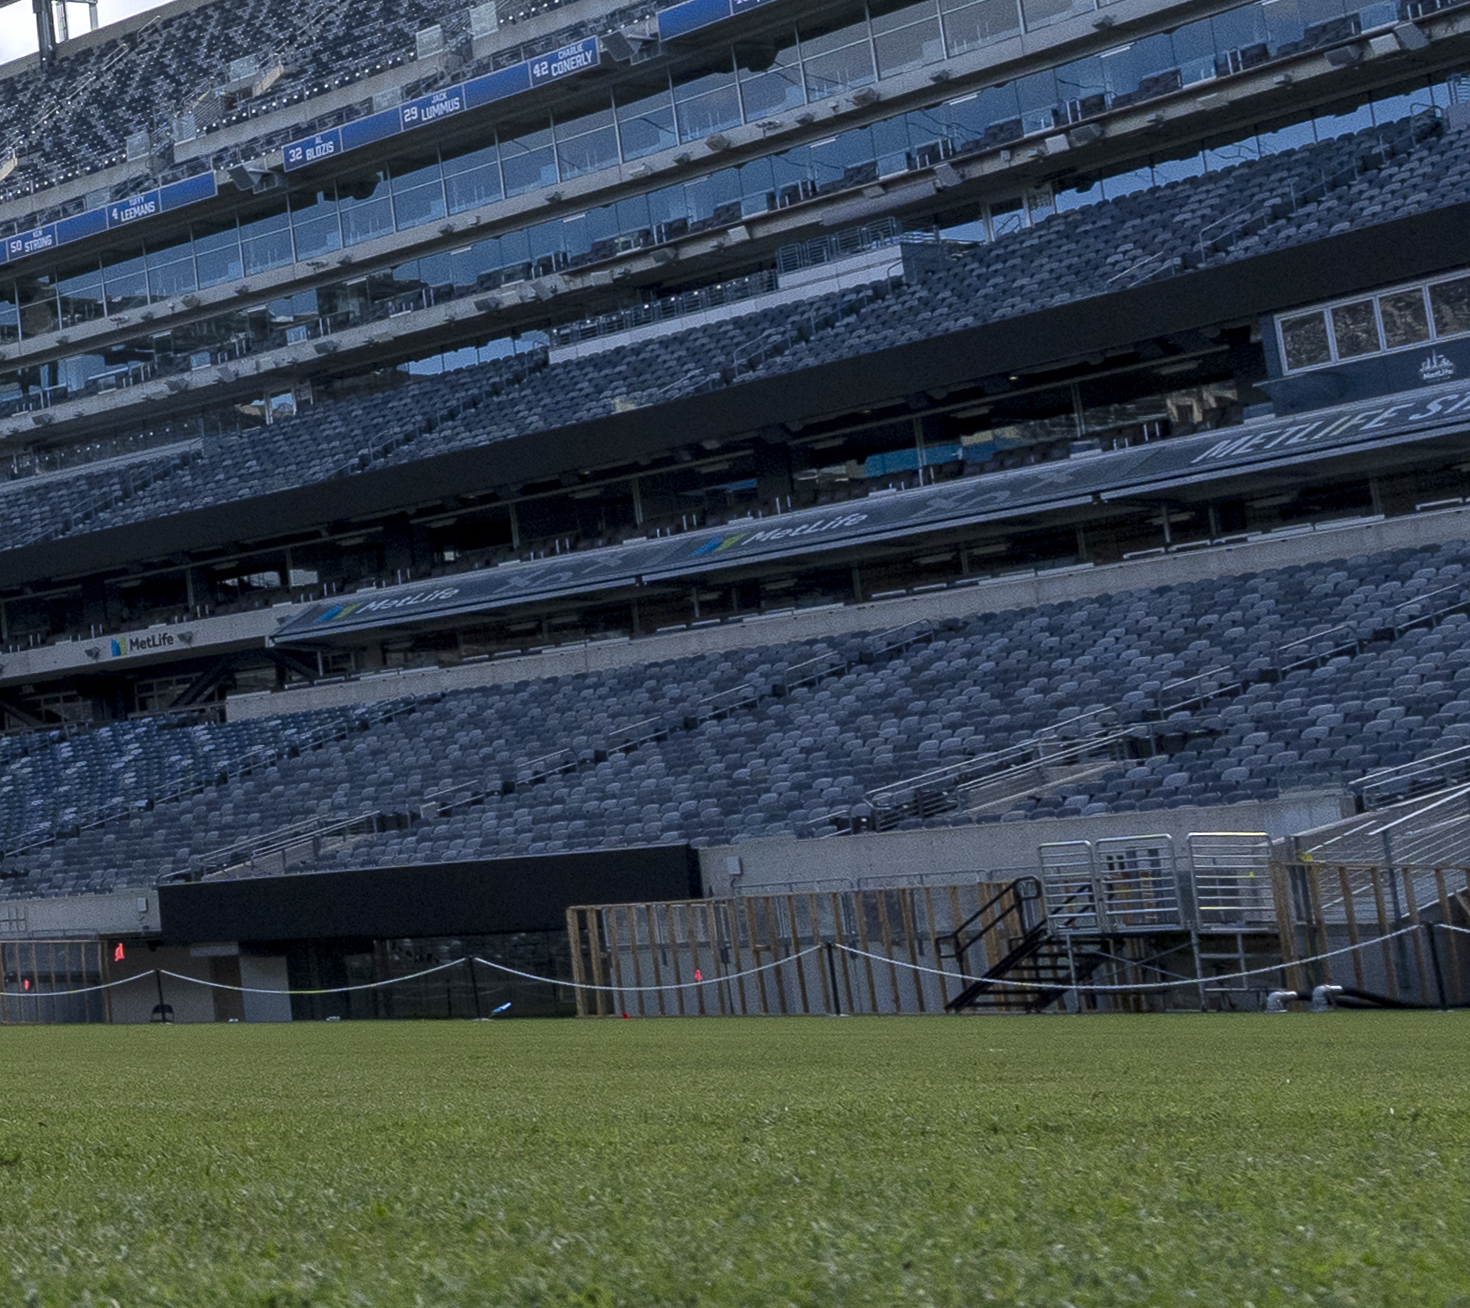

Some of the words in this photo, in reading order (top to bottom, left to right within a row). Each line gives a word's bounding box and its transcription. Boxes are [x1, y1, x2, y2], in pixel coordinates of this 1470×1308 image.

[533, 61, 549, 77] 42
[550, 50, 593, 77] CONERLY
[403, 106, 418, 122] 29
[421, 97, 460, 121] LUMMUS
[431, 92, 448, 104] JACK
[289, 147, 302, 162] 32
[306, 141, 334, 161] BLOZIS
[112, 208, 118, 220] 4
[10, 240, 22, 253] 50
[24, 234, 52, 252] STRONG
[1190, 403, 1415, 464] METLIFE
[741, 512, 868, 545] MetLife
[356, 587, 460, 615] MetLife
[129, 633, 174, 652] MetLife
